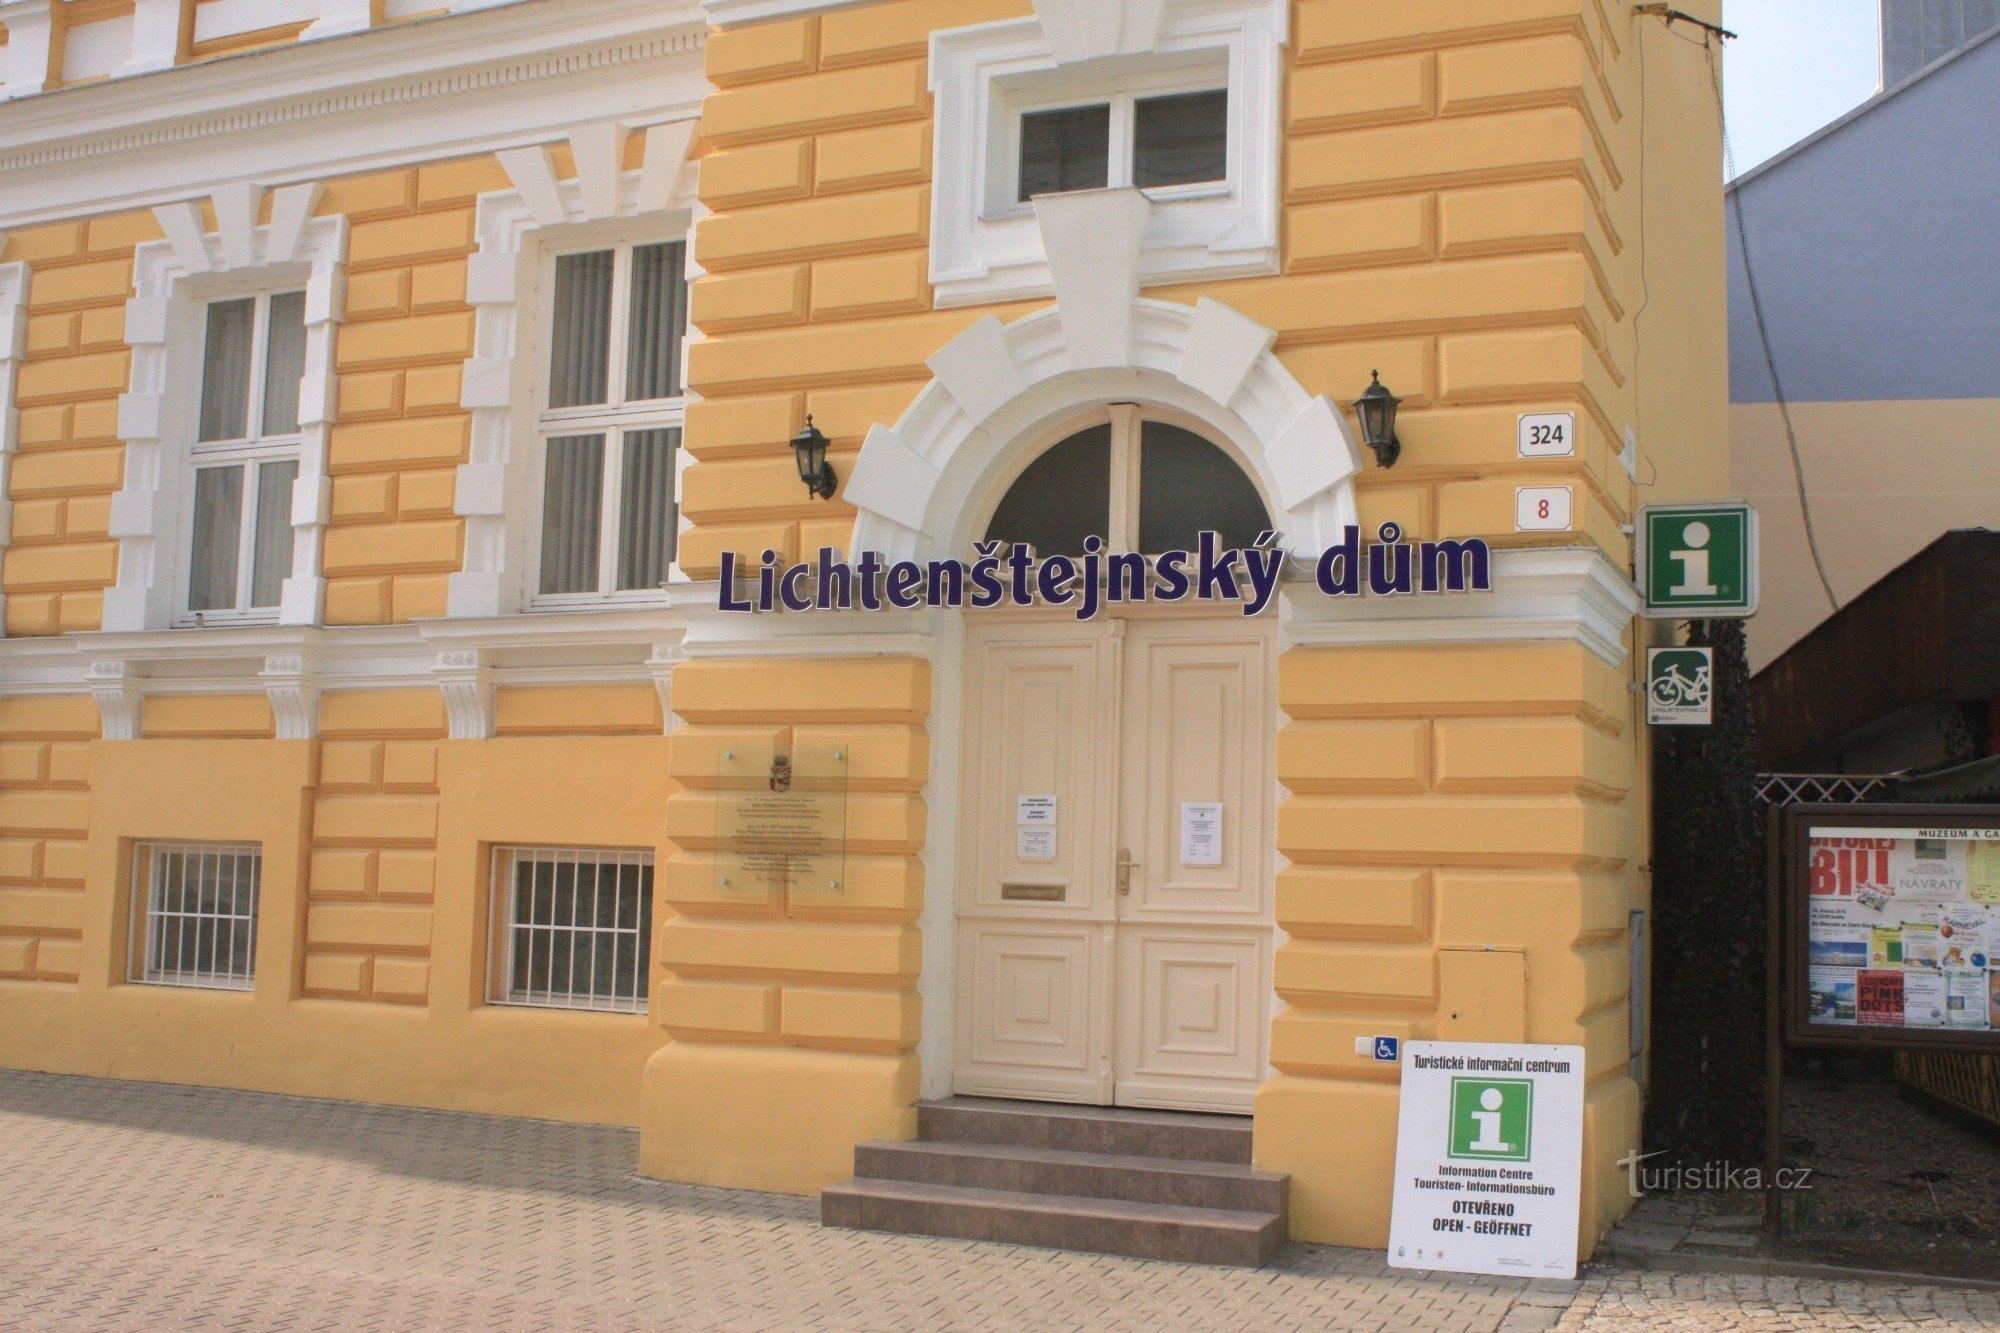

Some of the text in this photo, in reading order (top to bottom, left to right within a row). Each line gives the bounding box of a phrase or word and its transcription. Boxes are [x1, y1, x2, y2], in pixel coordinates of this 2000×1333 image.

[1529, 424, 1563, 445] 324
[1537, 499, 1549, 519] 8
[718, 522, 1493, 622] Lichtenštejnský dům
[1918, 829, 1968, 838] MUZEUM
[1972, 830, 1980, 838] A
[1900, 876, 1962, 890] NÁVRATY
[1942, 916, 1987, 930] KARNEVAL
[1413, 1054, 1570, 1074] Turistické informační centrum
[1438, 1165, 1533, 1180] Information Centre
[1414, 1178, 1555, 1196] Touristen- Informationsbüro
[1452, 1199, 1515, 1217] OTEVŘENO
[1432, 1218, 1464, 1233] OPEN
[1473, 1218, 1533, 1237] GEÖFFNET
